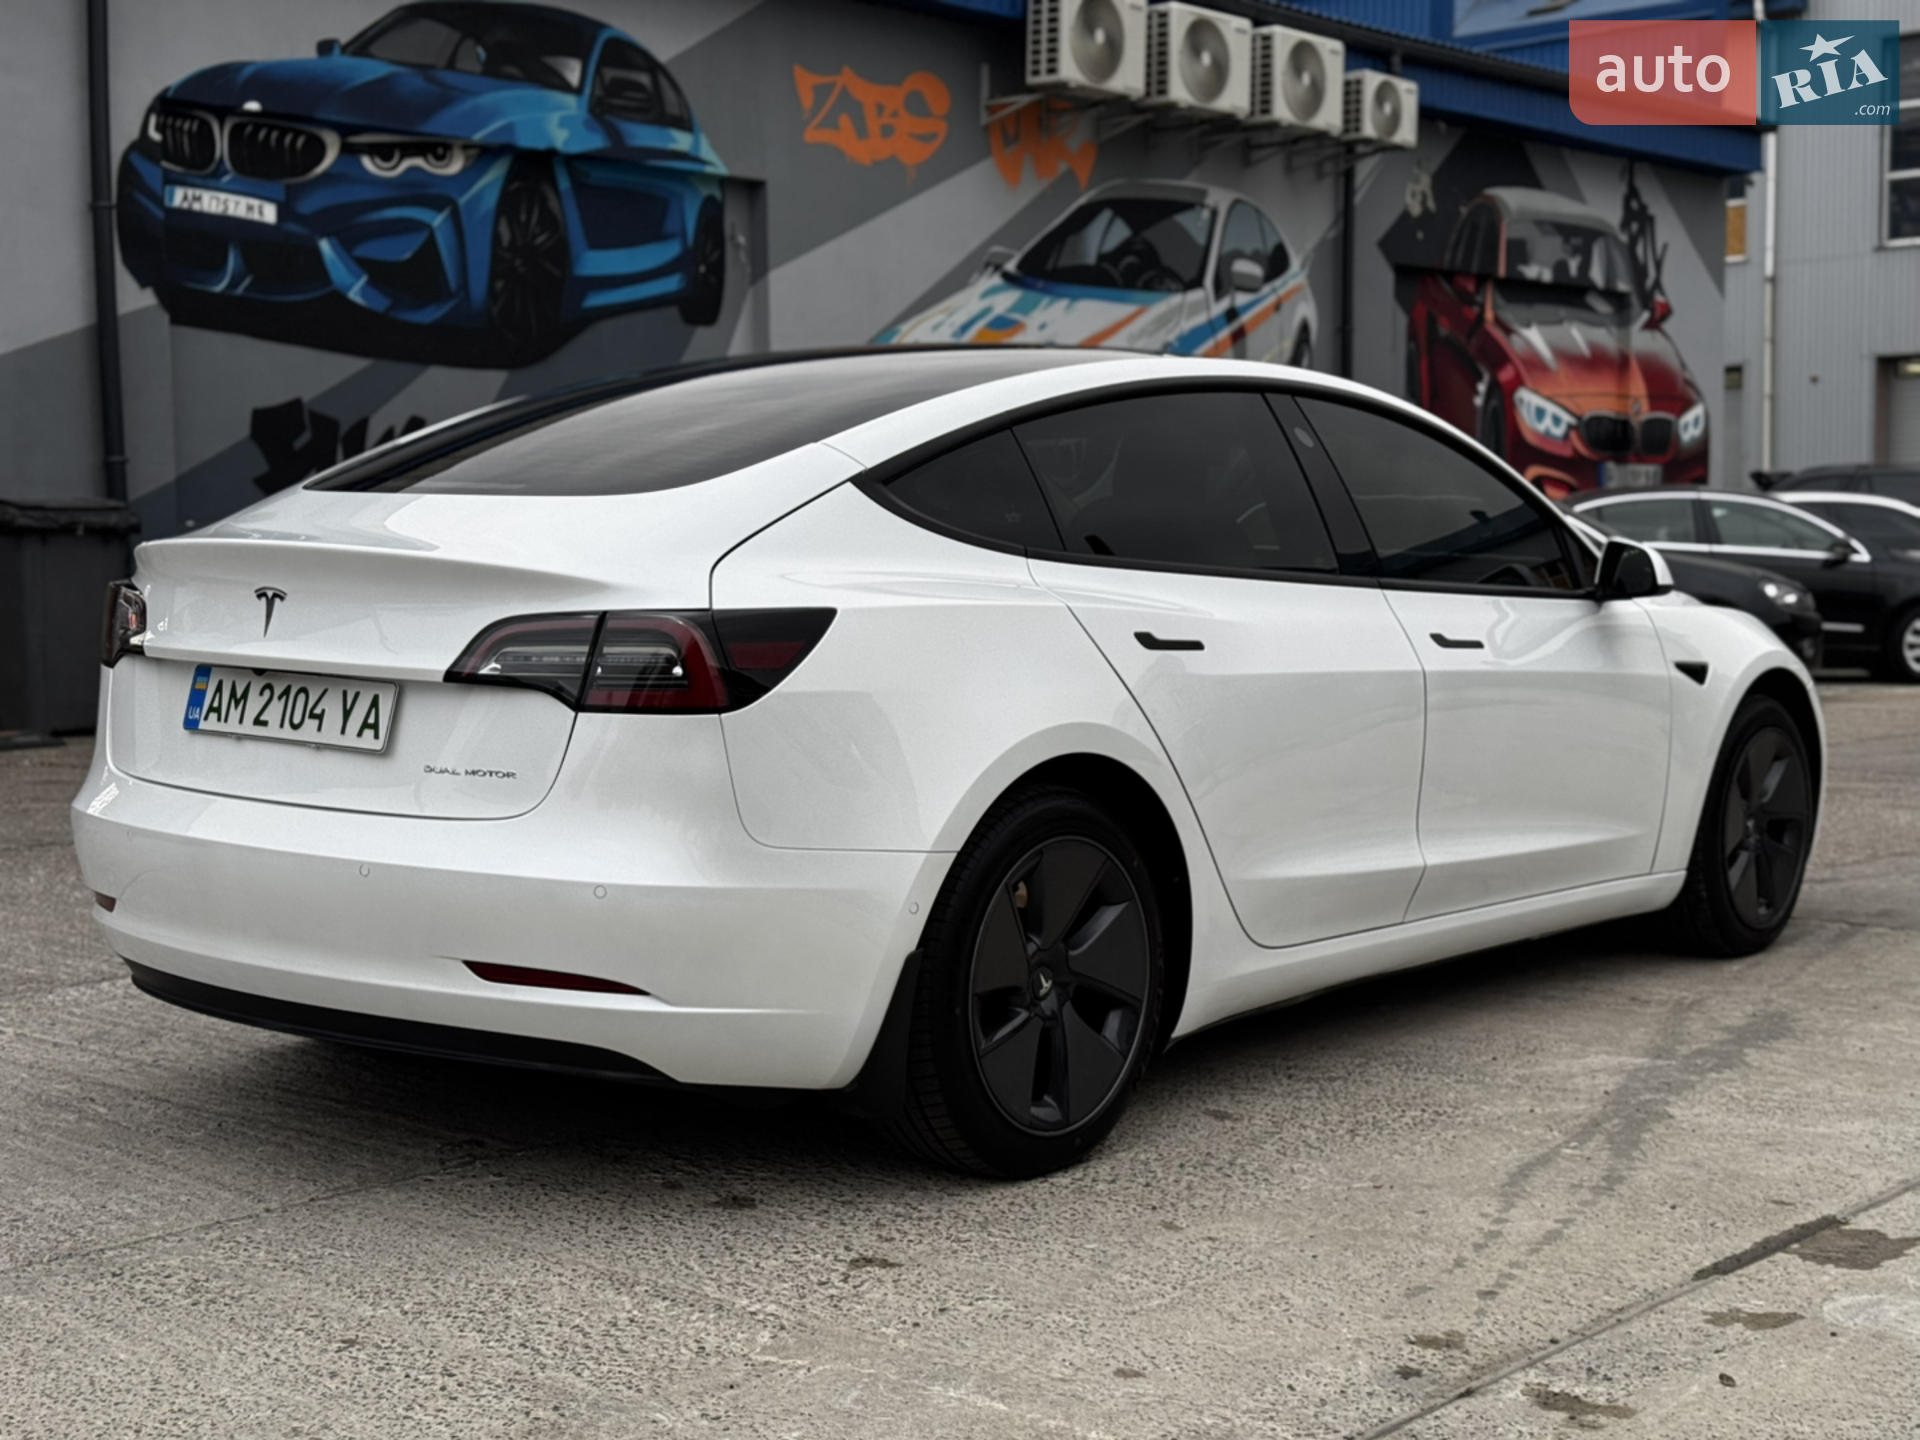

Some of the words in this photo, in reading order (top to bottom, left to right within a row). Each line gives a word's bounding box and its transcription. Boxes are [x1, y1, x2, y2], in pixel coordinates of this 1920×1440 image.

[188, 705, 200, 720] UA
[203, 679, 252, 725] AM
[253, 682, 329, 733] 2104
[340, 689, 380, 740] YA
[423, 764, 461, 776] DUAL
[464, 768, 517, 779] MOTOR
